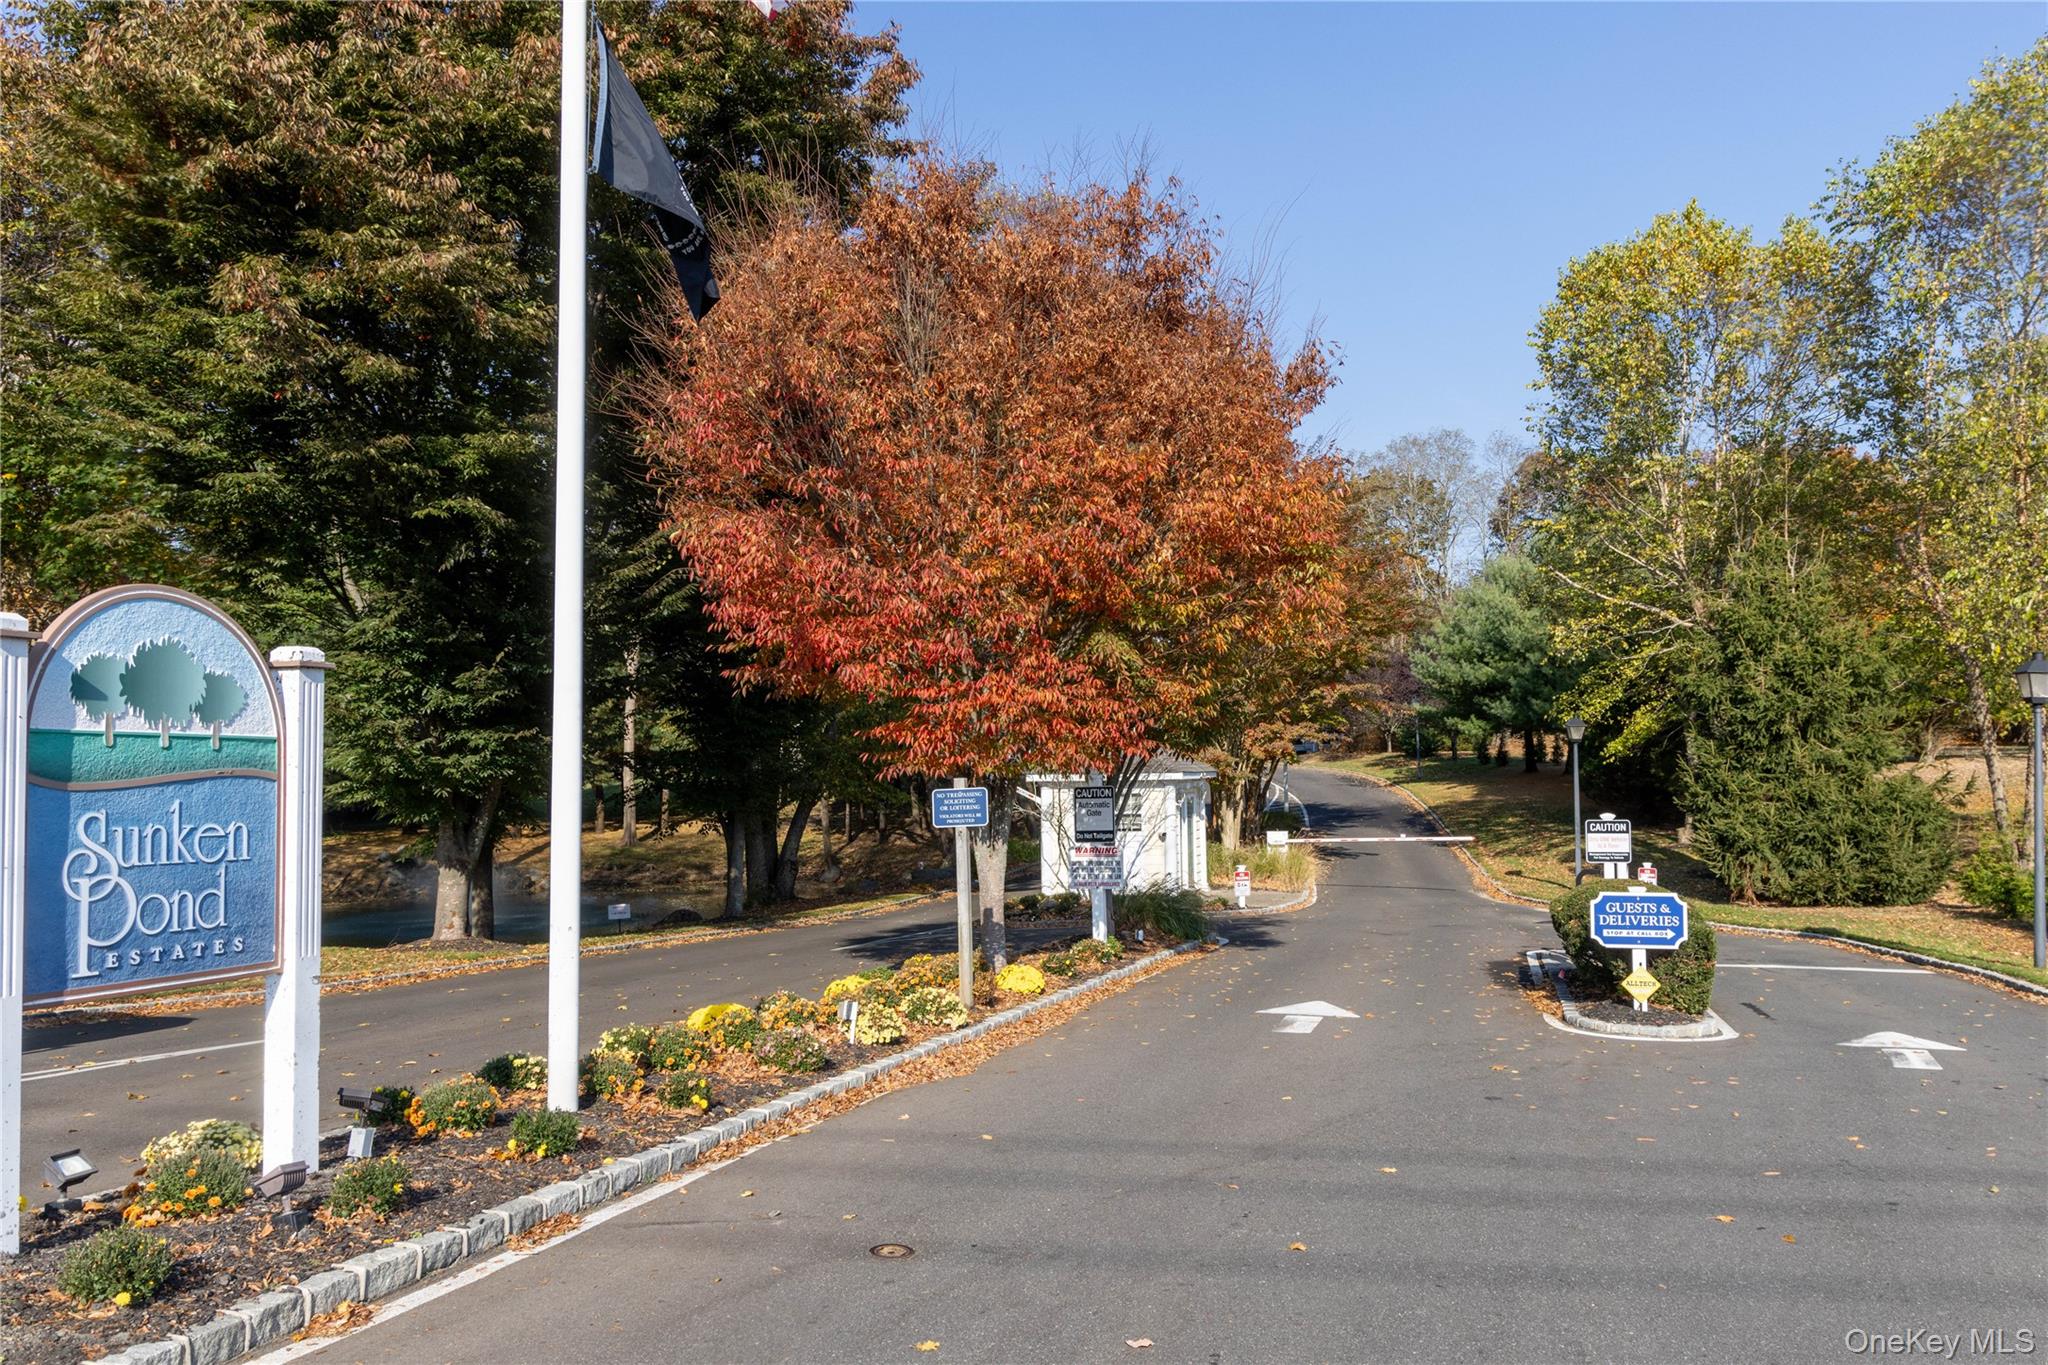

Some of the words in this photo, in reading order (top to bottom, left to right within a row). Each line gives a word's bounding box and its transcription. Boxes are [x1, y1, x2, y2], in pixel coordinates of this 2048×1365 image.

[1075, 788, 1112, 798] CAUTION
[1078, 801, 1111, 809] Automatic
[1589, 823, 1627, 832] CAUTION
[1093, 832, 1114, 840] Tailgate
[63, 799, 251, 901] Sunken
[1075, 846, 1119, 854] WARNING
[1605, 902, 1658, 914] GUESTS
[1659, 903, 1671, 914] &
[71, 864, 228, 979] Pond
[1599, 914, 1680, 927] DELIVERIES
[104, 936, 245, 969] ESTATES
